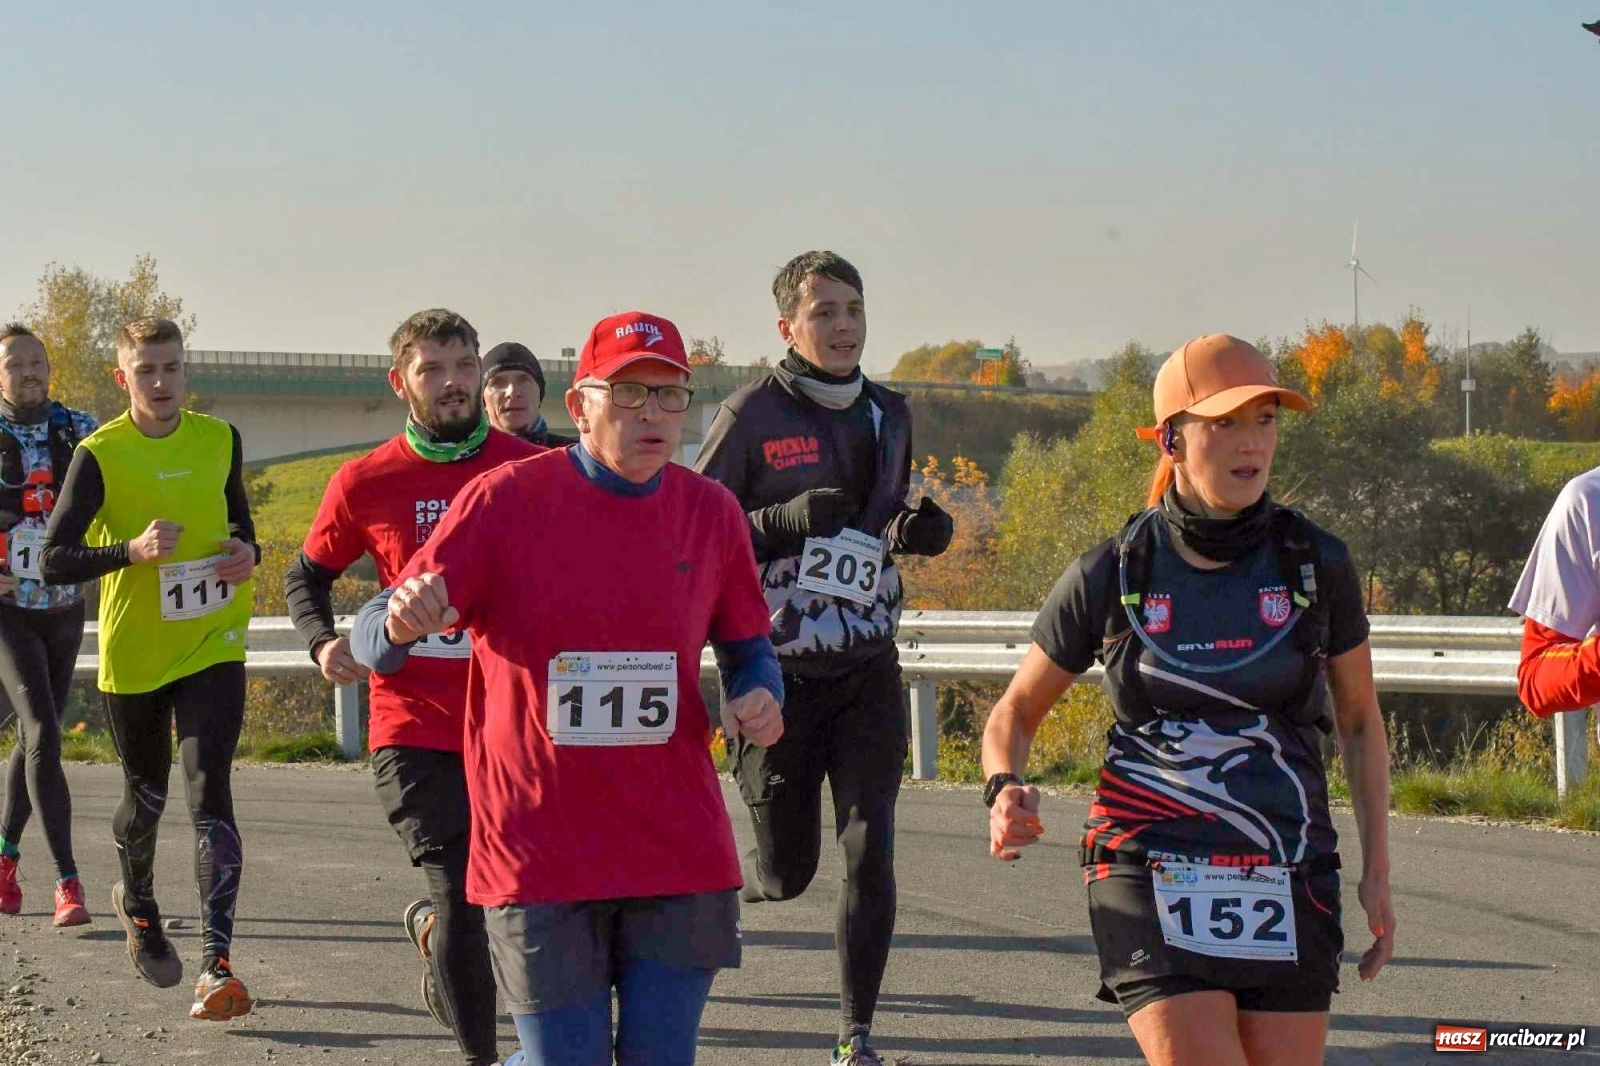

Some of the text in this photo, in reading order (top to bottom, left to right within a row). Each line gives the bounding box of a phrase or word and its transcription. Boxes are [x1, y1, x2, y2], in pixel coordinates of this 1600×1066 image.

[616, 322, 659, 339] RAUCH
[416, 500, 449, 511] POL
[416, 524, 432, 543] R
[805, 547, 877, 592] 203
[168, 579, 228, 609] 111
[597, 662, 673, 671] www.personalbest.pl
[559, 685, 670, 728] 115
[1204, 872, 1285, 886] www.personalbest.pl
[1167, 896, 1288, 941] 152
